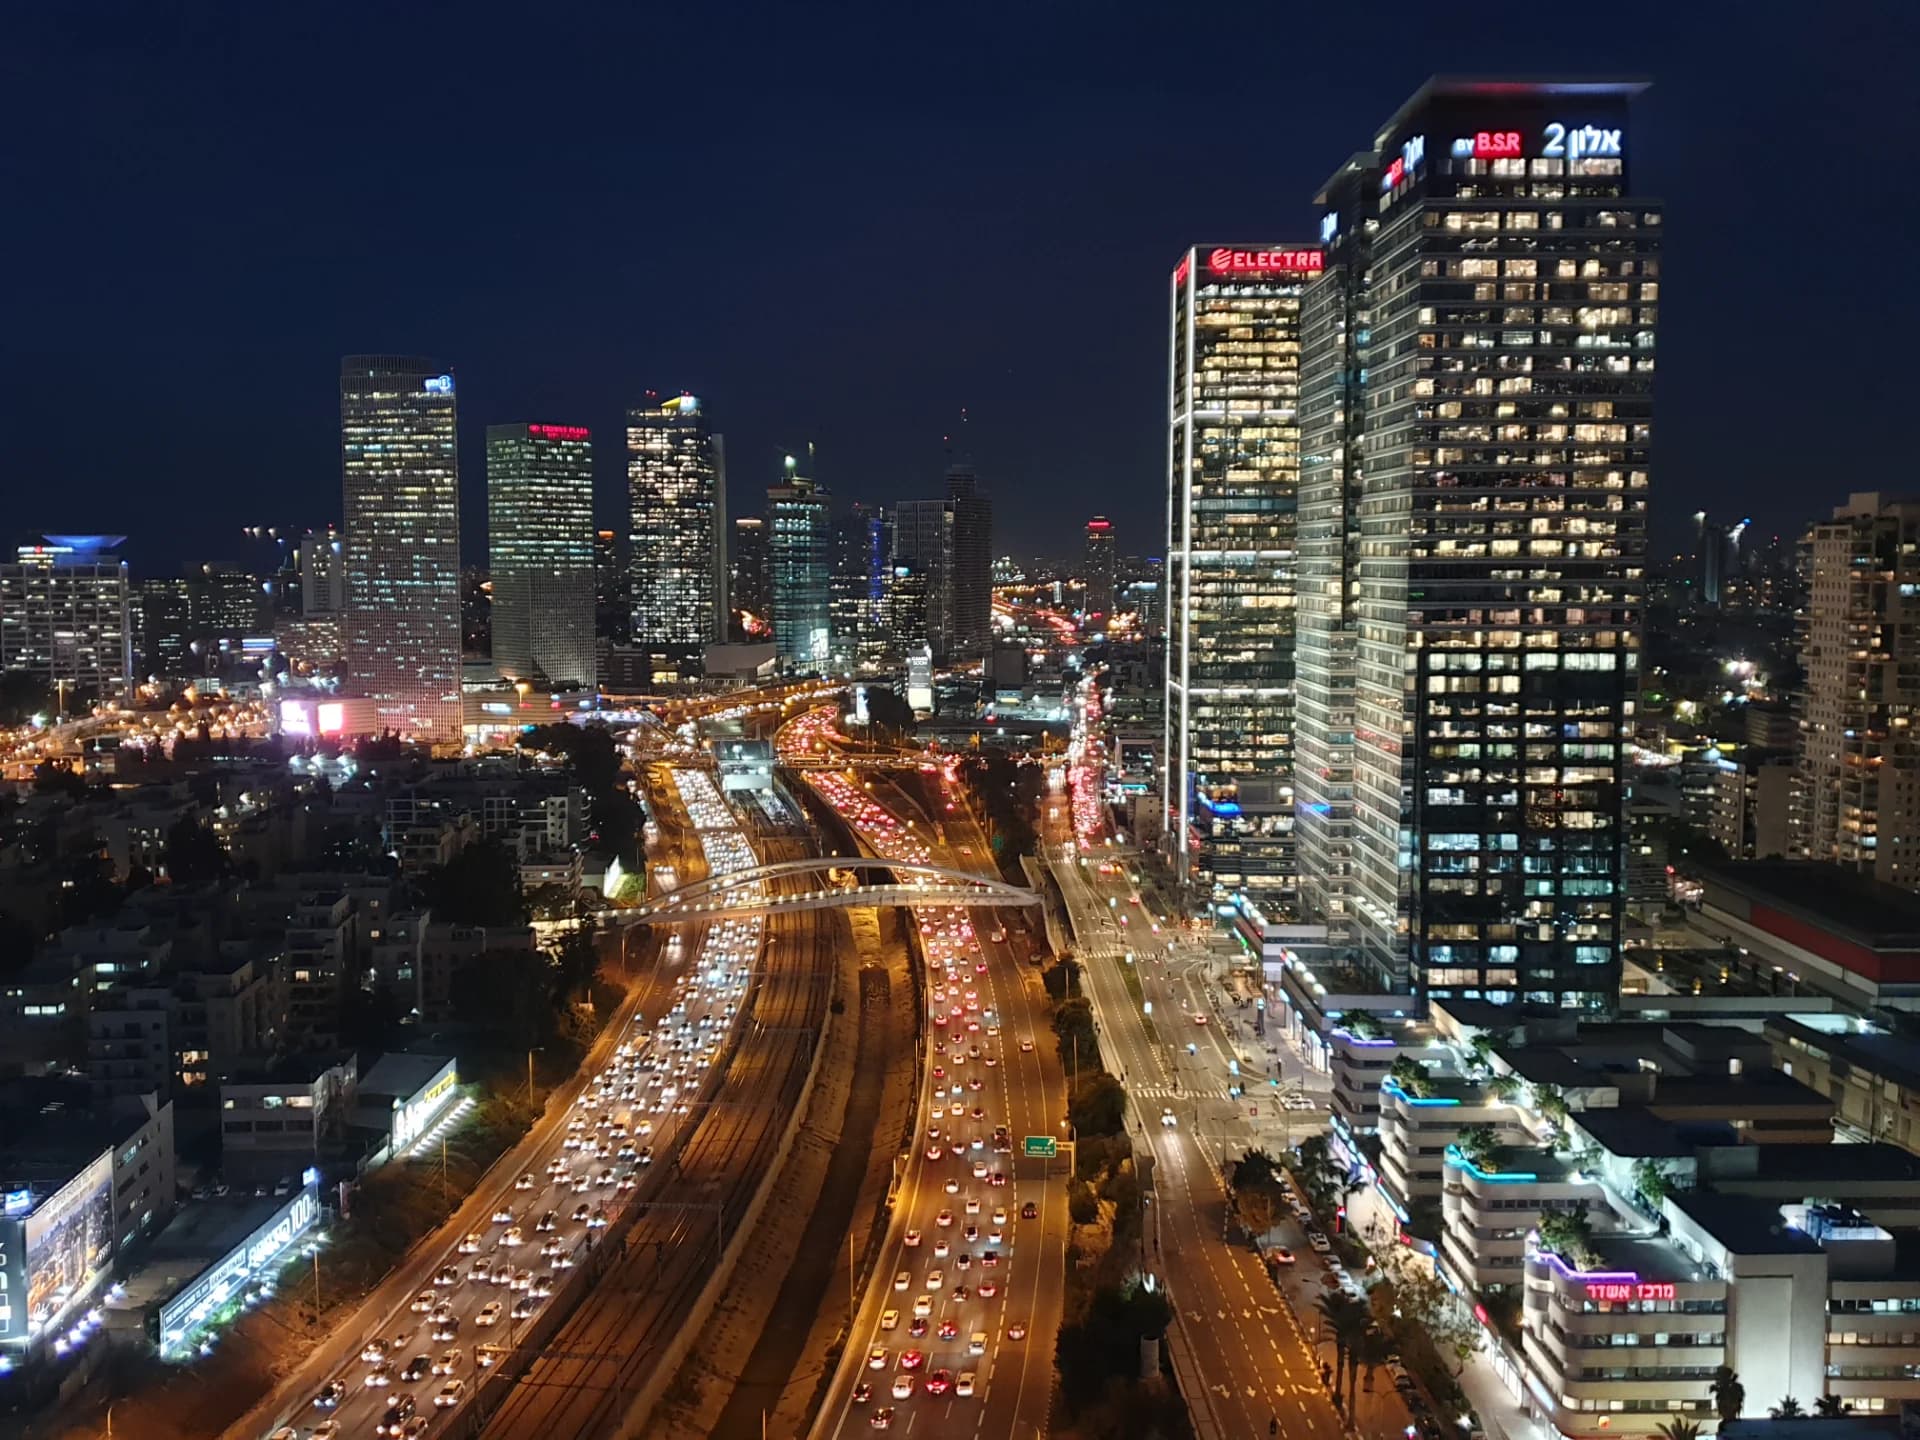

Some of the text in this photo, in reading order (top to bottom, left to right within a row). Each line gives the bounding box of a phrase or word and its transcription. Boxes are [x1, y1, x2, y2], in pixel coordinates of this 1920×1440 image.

[1544, 122, 1622, 158] אלון 2
[1233, 252, 1322, 267] ELECTRA
[290, 1193, 311, 1234] 100
[1586, 1284, 1675, 1298] מרכז אשדר
